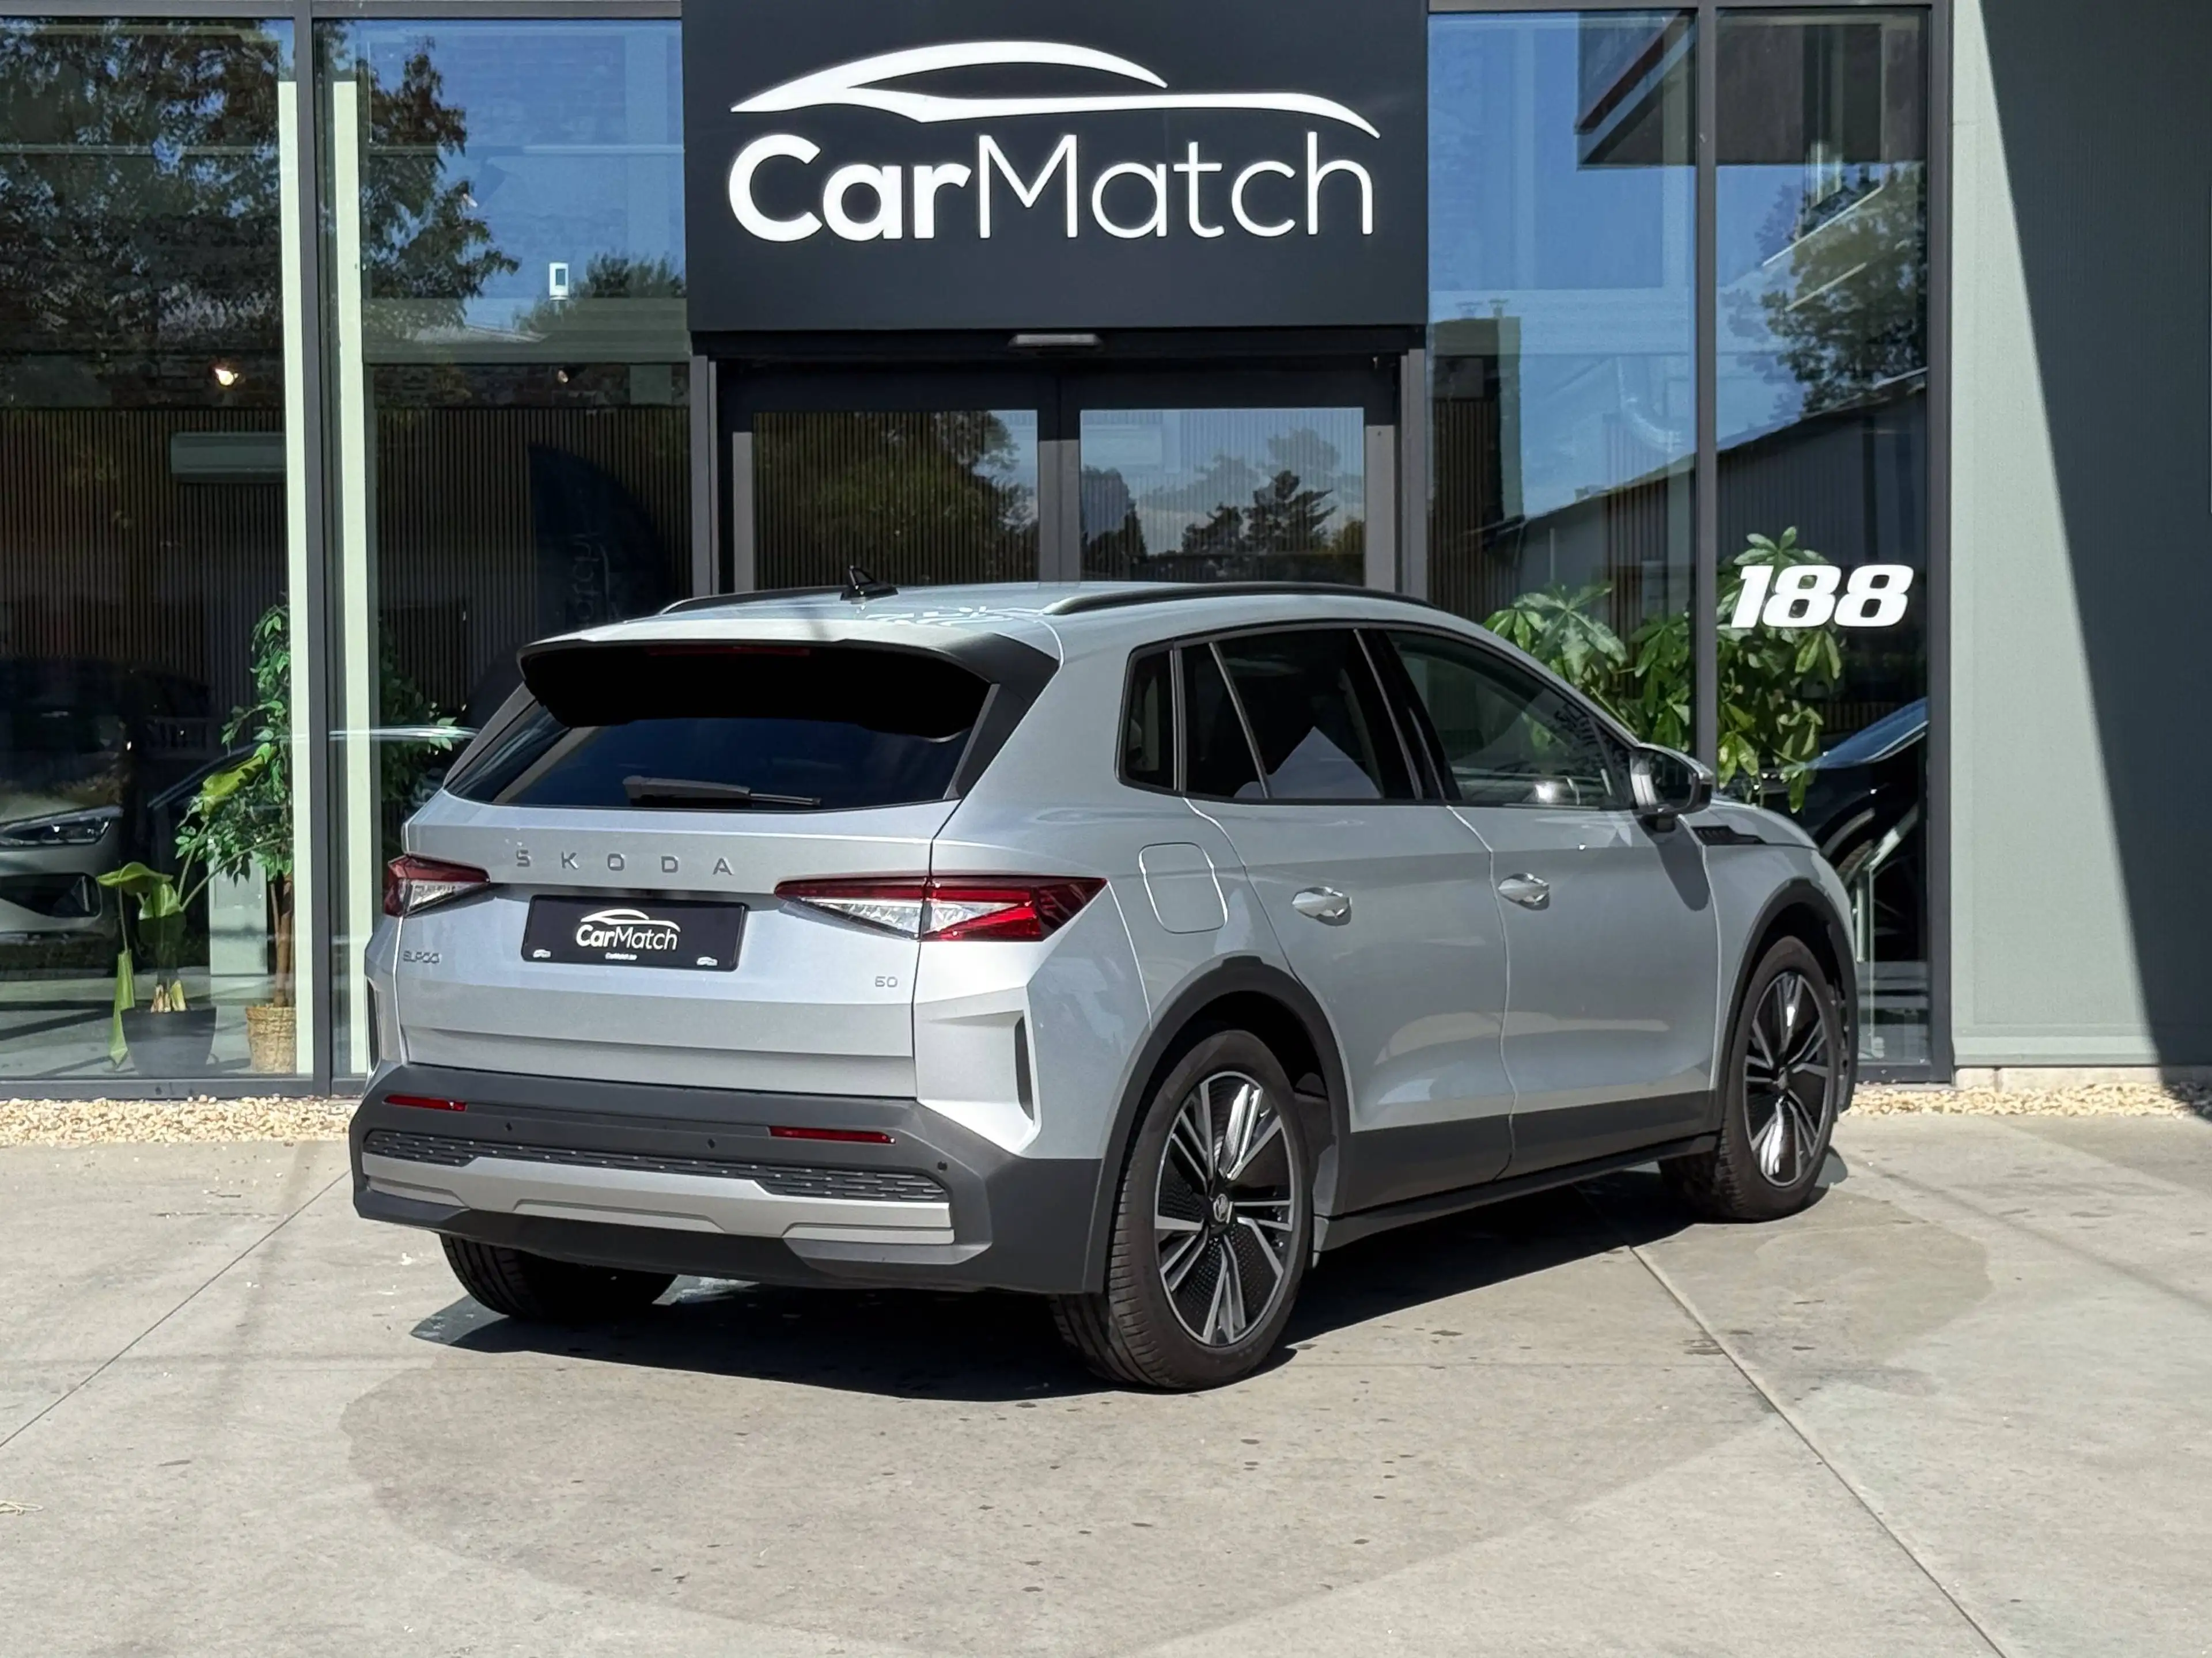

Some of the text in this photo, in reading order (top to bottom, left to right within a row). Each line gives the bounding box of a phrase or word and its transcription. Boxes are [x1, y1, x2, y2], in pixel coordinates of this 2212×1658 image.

[729, 131, 1373, 242] CarMatch
[1730, 564, 1914, 628] 188
[576, 924, 678, 950] CarMatch
[875, 976, 898, 988] 60
